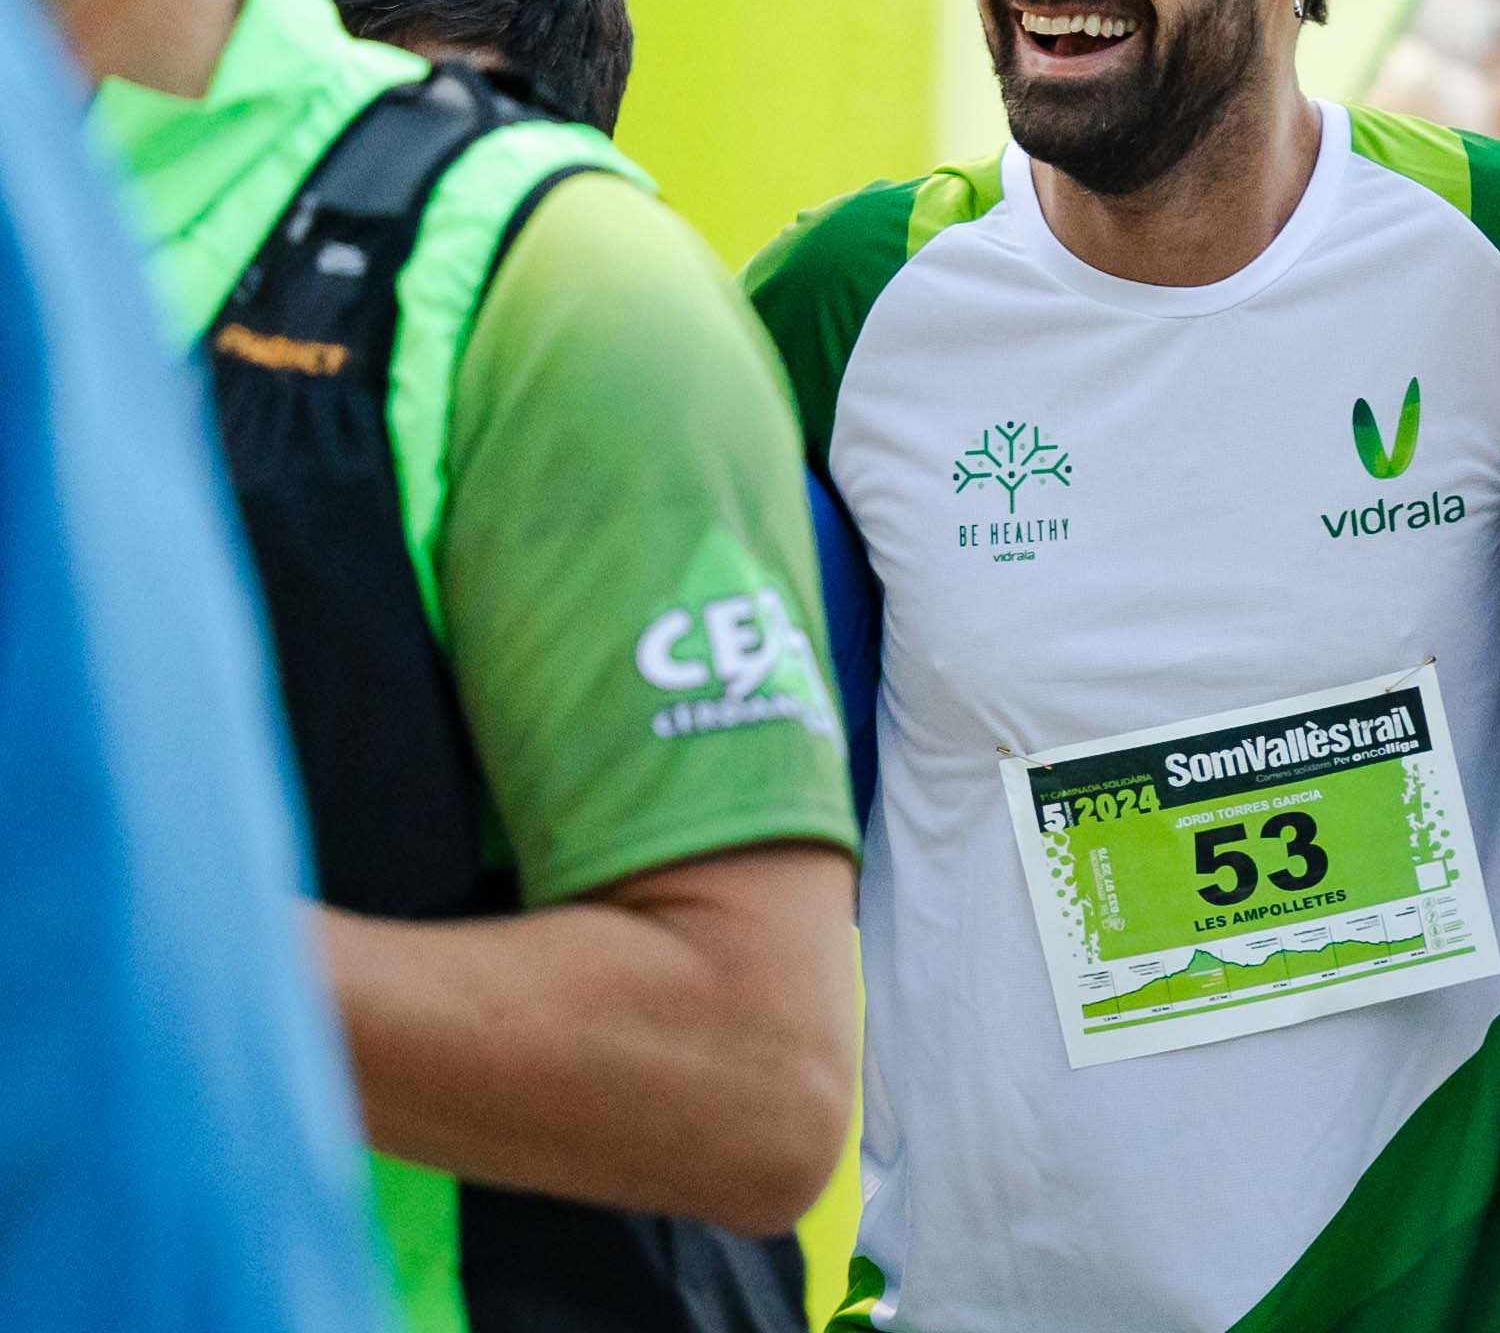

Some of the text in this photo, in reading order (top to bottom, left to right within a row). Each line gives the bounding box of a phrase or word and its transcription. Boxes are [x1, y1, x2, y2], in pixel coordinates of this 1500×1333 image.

[958, 518, 1071, 548] BE HEALTHY
[1320, 490, 1467, 540] vidrala
[992, 549, 1037, 563] vidrala
[1164, 705, 1417, 789] SomVallèstrail
[1334, 755, 1350, 766] Per
[1351, 739, 1420, 762] oncolliga
[1042, 802, 1067, 834] 5
[1074, 784, 1161, 825] 2024
[1175, 811, 1215, 830] JORDI
[1216, 800, 1270, 823] TORRES
[1194, 811, 1329, 906] 53
[1194, 915, 1227, 933] LES
[1232, 889, 1348, 925] AMPOLLETES
